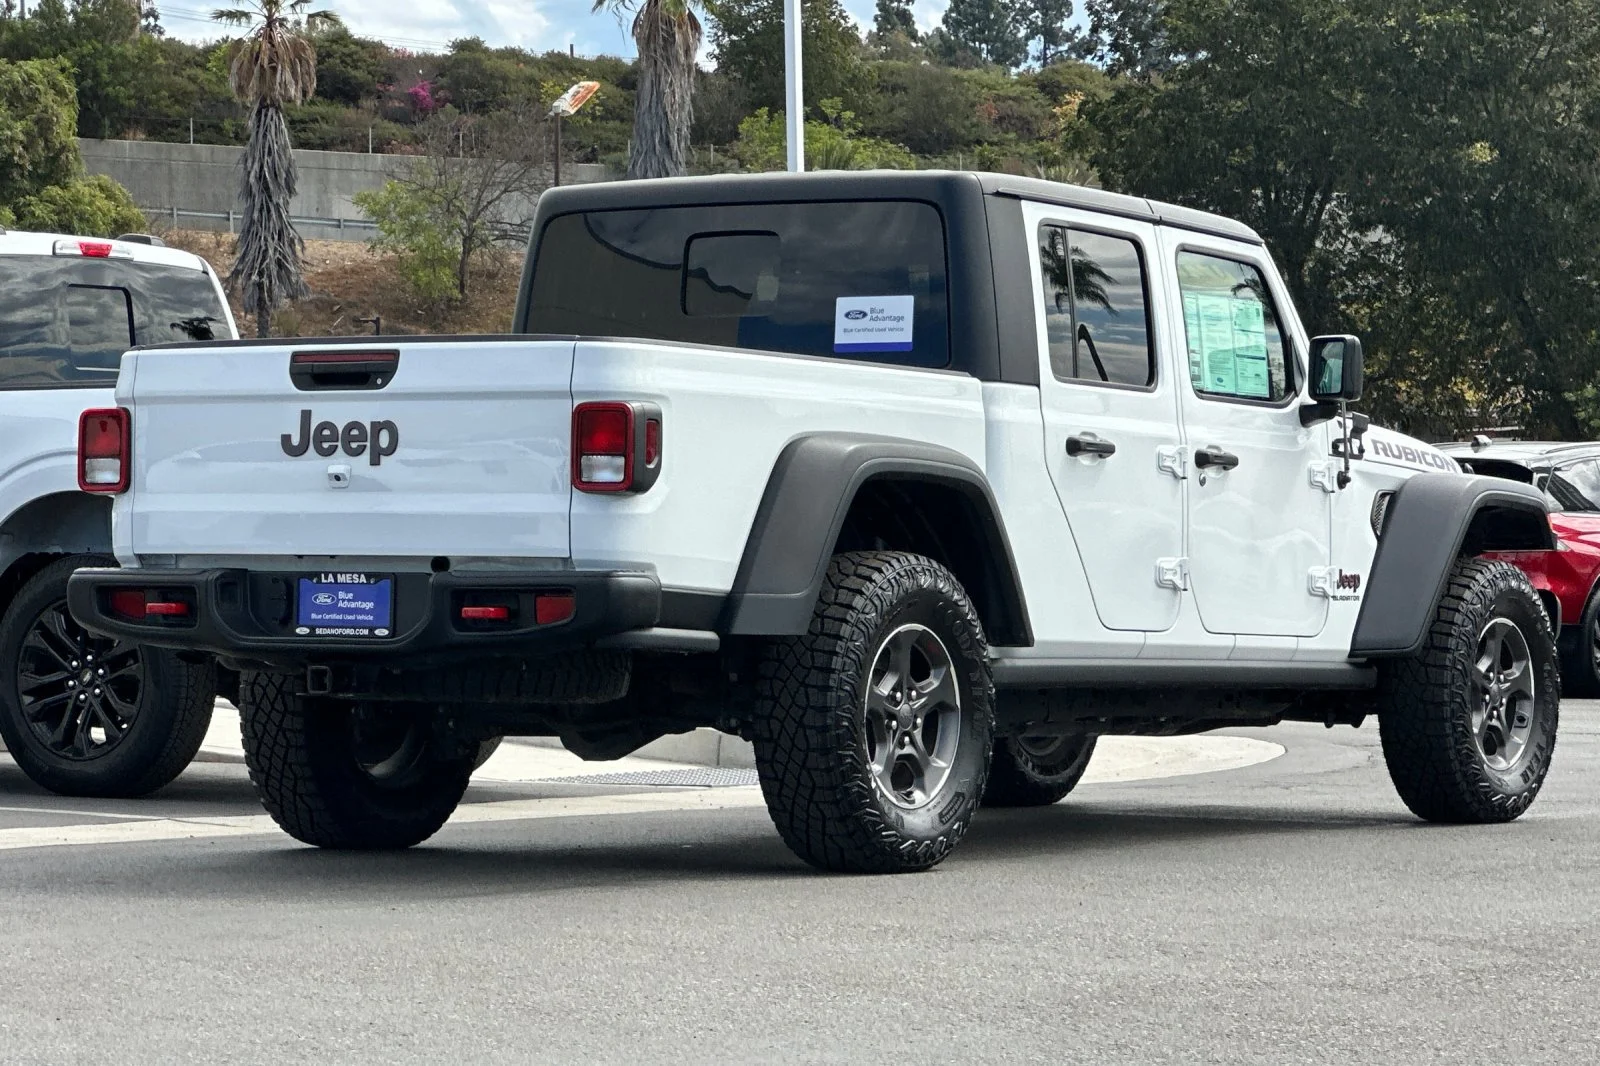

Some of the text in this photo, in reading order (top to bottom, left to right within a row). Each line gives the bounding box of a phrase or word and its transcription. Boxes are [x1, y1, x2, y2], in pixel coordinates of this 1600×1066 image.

[869, 315, 905, 323] Advantage
[280, 409, 399, 466] Jeep
[1371, 439, 1457, 473] RUBICON
[321, 573, 367, 584] LA MESA
[1337, 569, 1360, 593] Jeep
[338, 591, 353, 599] Blue
[338, 600, 374, 610] Advantage
